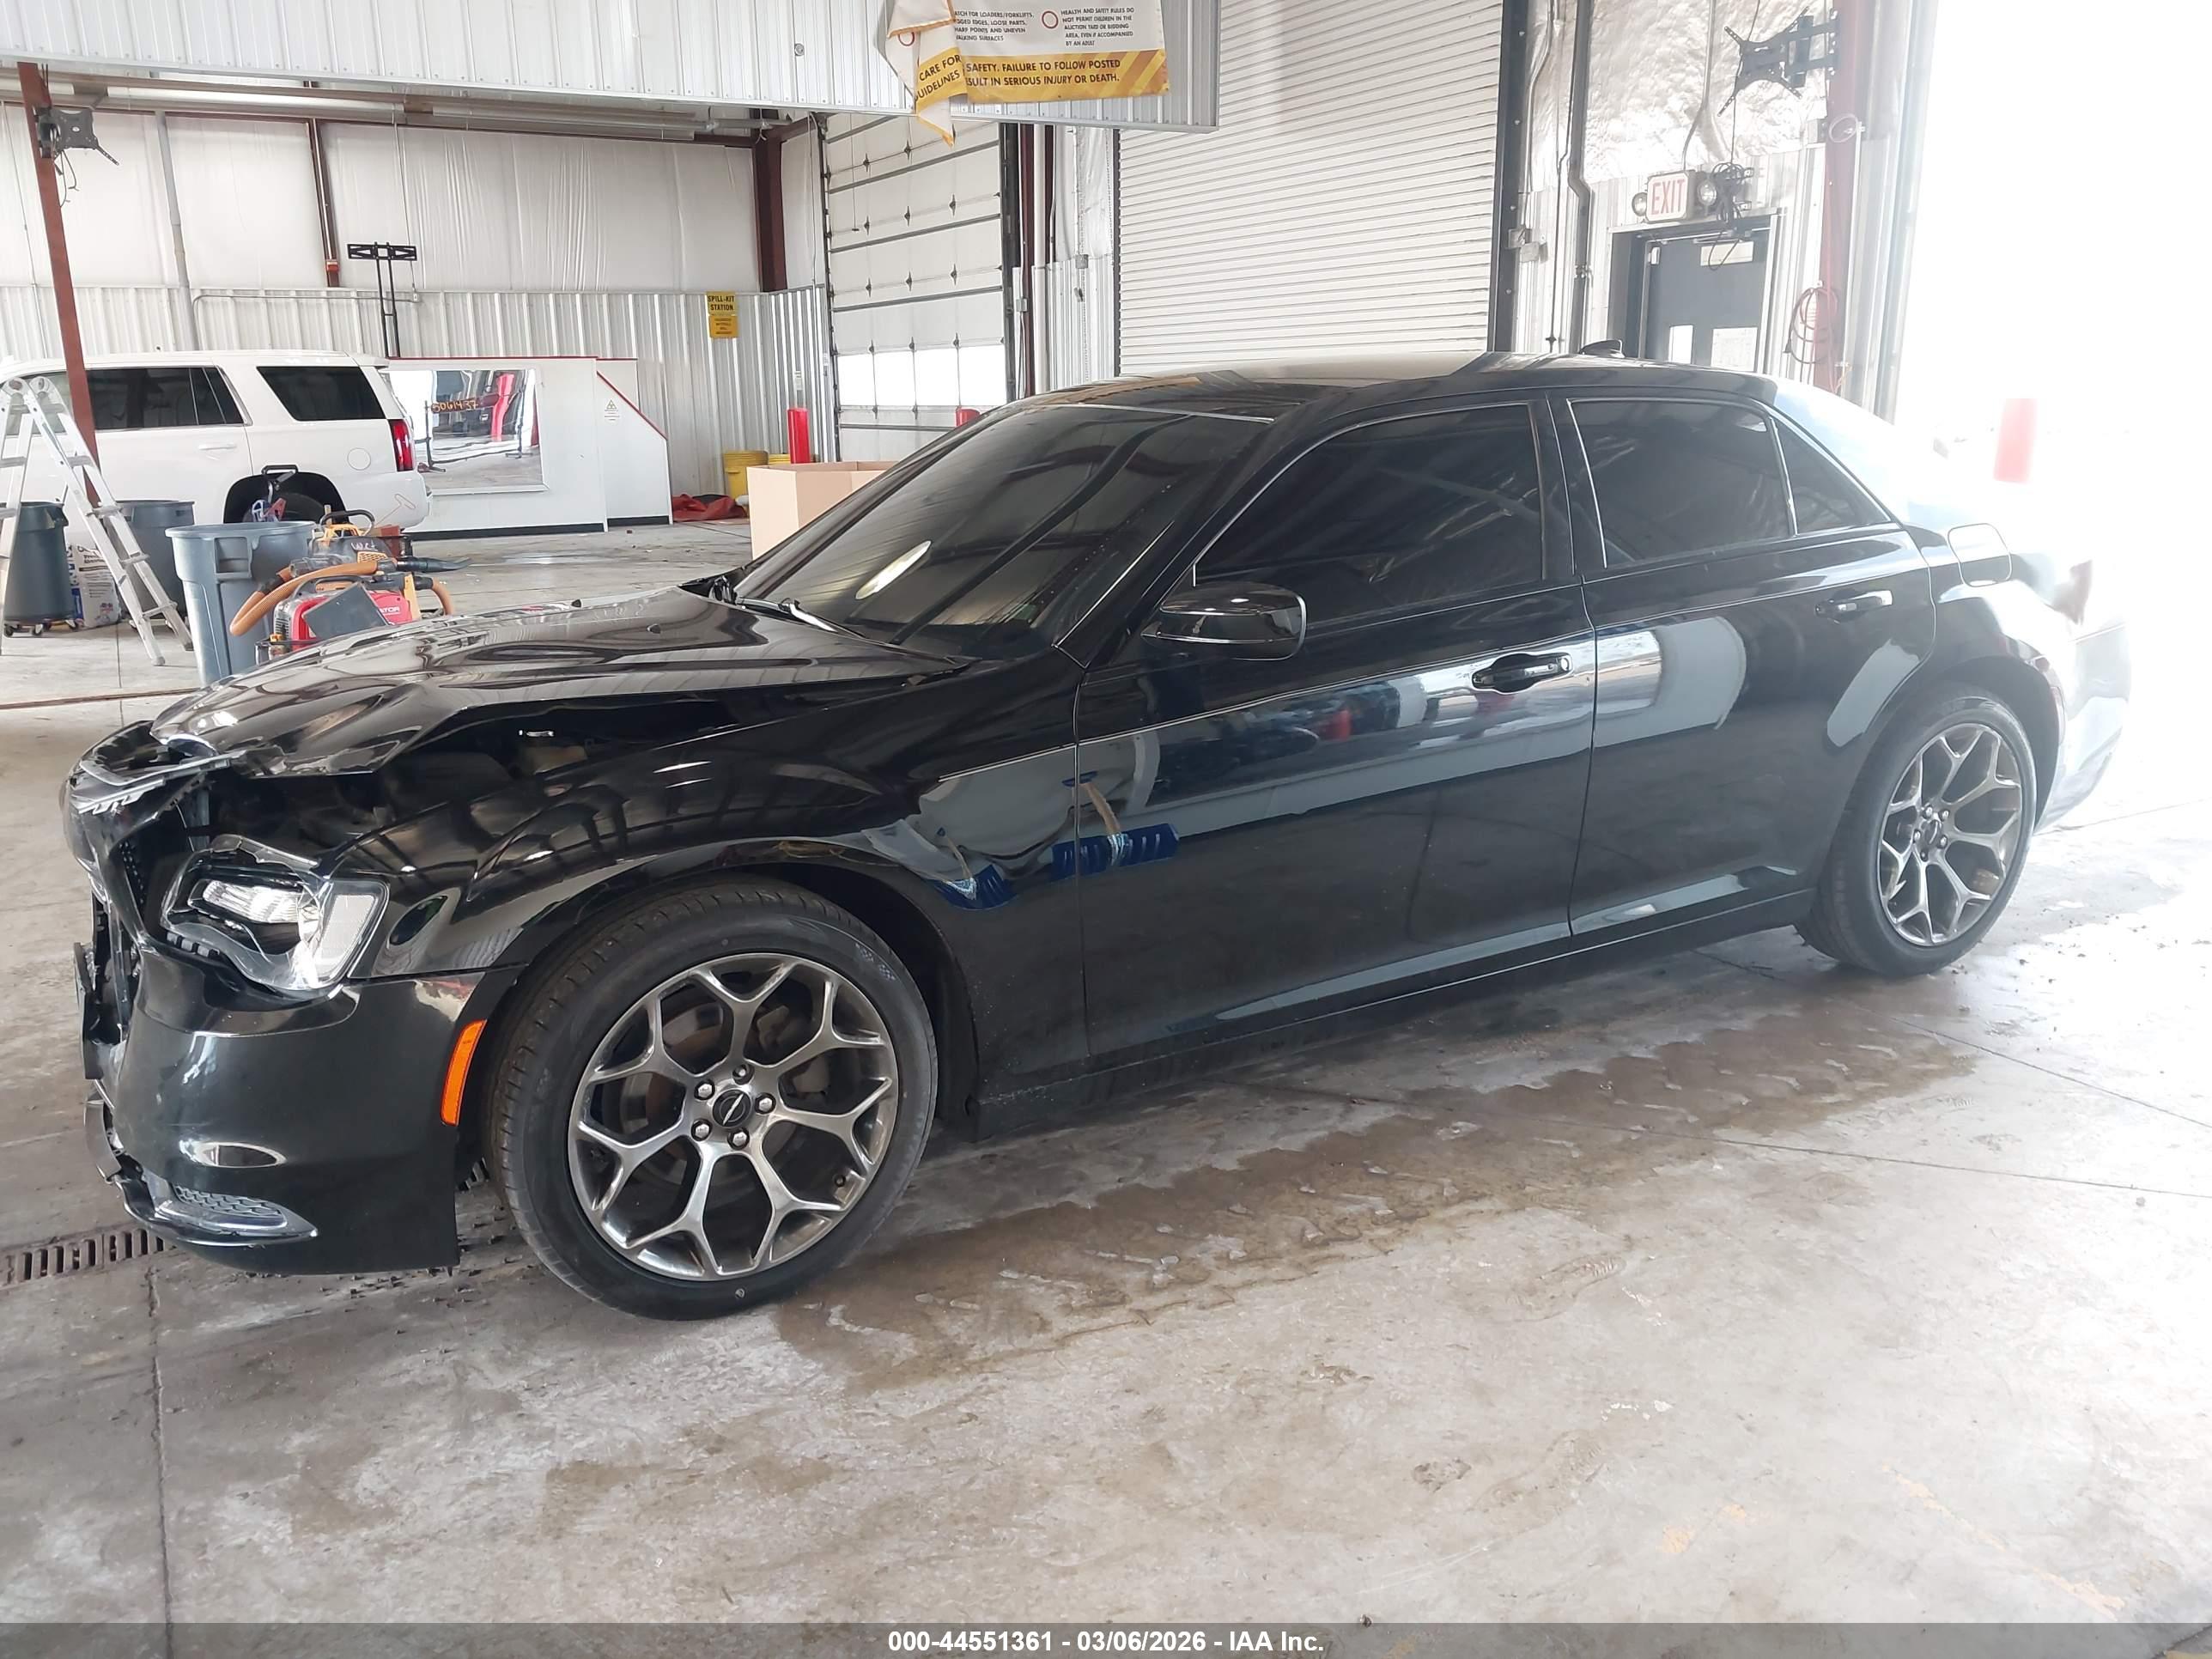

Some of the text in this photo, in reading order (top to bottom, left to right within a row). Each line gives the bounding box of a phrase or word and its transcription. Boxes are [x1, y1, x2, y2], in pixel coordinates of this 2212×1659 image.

[919, 54, 963, 82] CARE FOR
[1002, 63, 1036, 71] FAILURE
[1039, 62, 1051, 70] TO
[1054, 60, 1085, 70] FOLLOW
[1089, 59, 1121, 69] POSTED
[916, 70, 961, 100] UIDELINES
[991, 76, 1001, 86] IN
[1003, 76, 1041, 85] SERIOUS
[1043, 75, 1073, 84] INJURY
[1074, 75, 1087, 83] OR
[1089, 73, 1120, 82] DEATH.
[1651, 179, 1685, 216] EXIT
